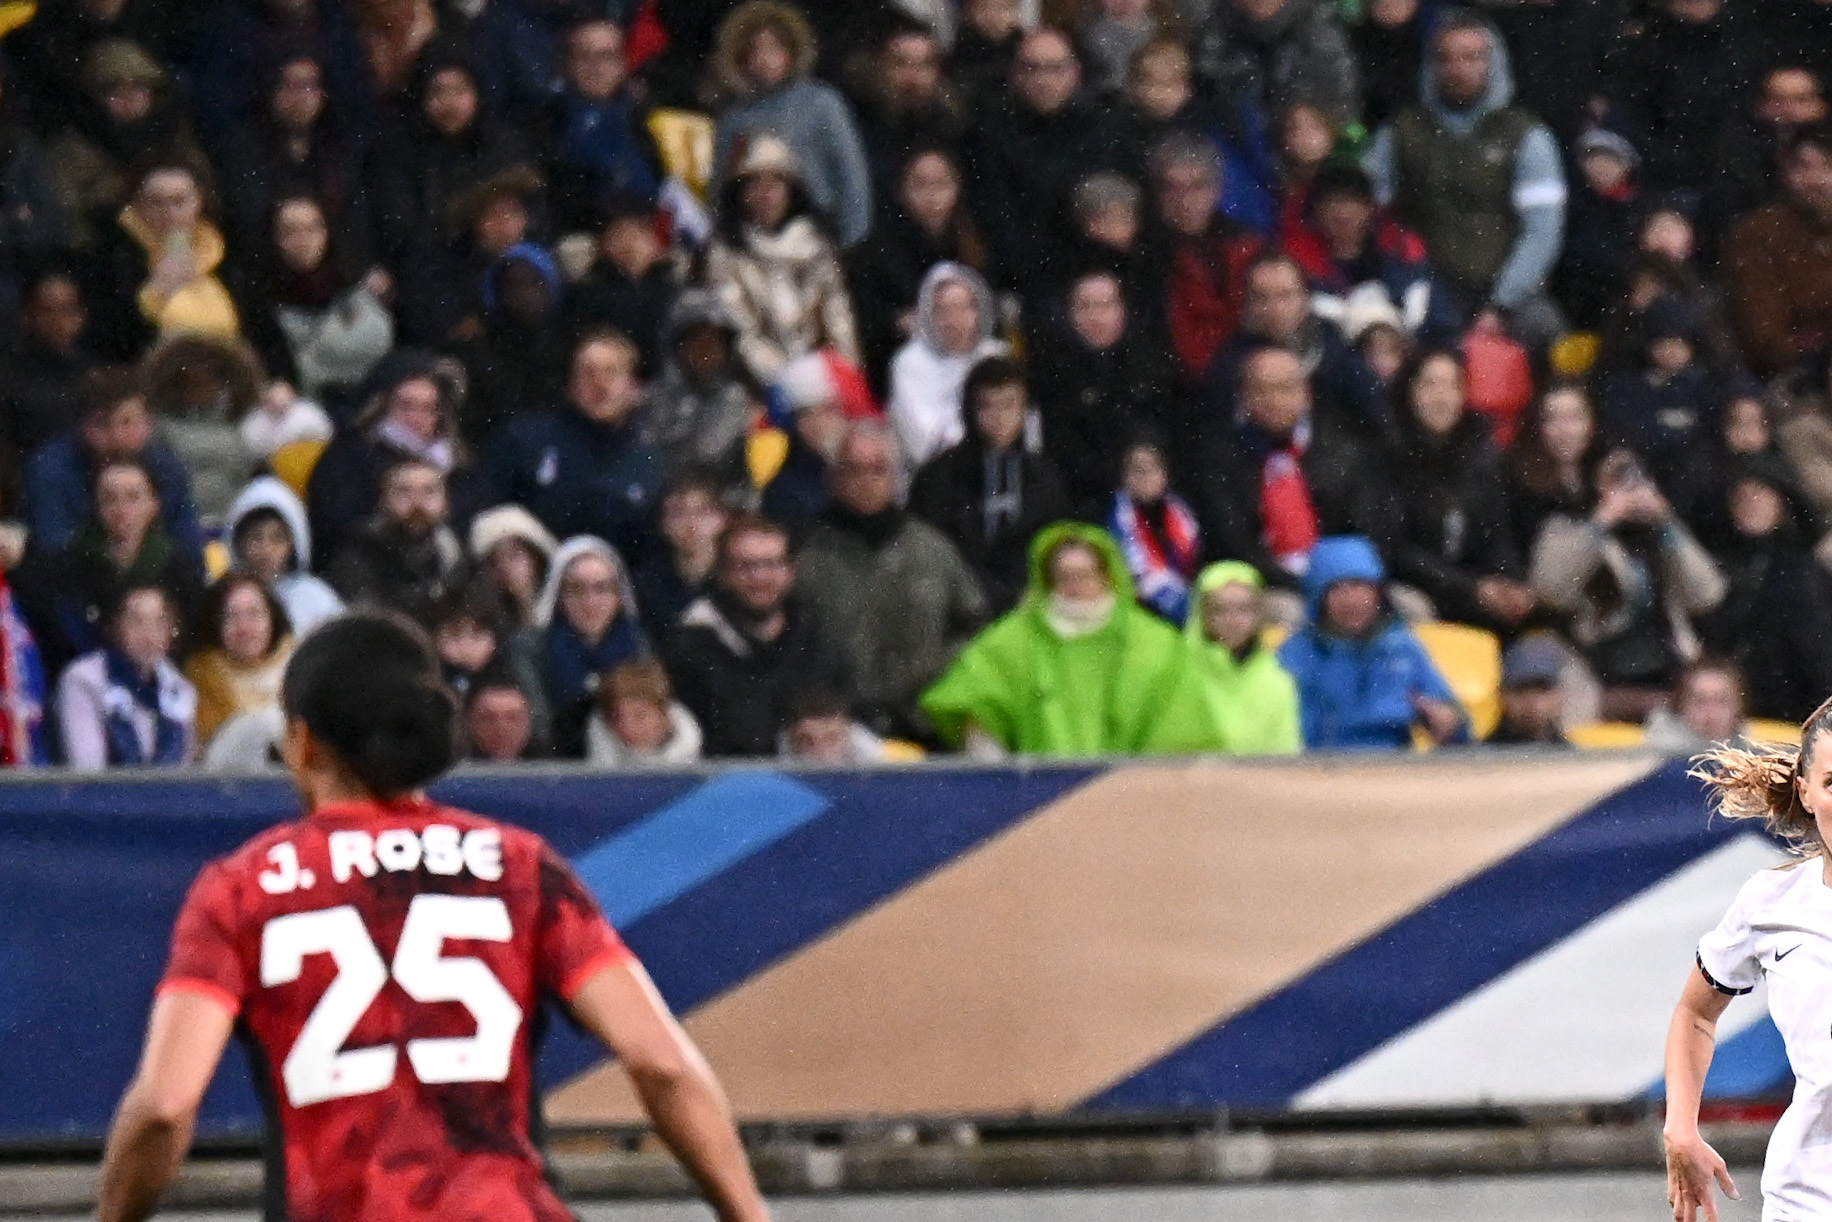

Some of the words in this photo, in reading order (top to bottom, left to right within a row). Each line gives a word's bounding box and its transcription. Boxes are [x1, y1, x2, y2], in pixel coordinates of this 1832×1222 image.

[258, 841, 316, 894] J.
[328, 823, 505, 883] ROSE
[260, 893, 523, 1109] 25
